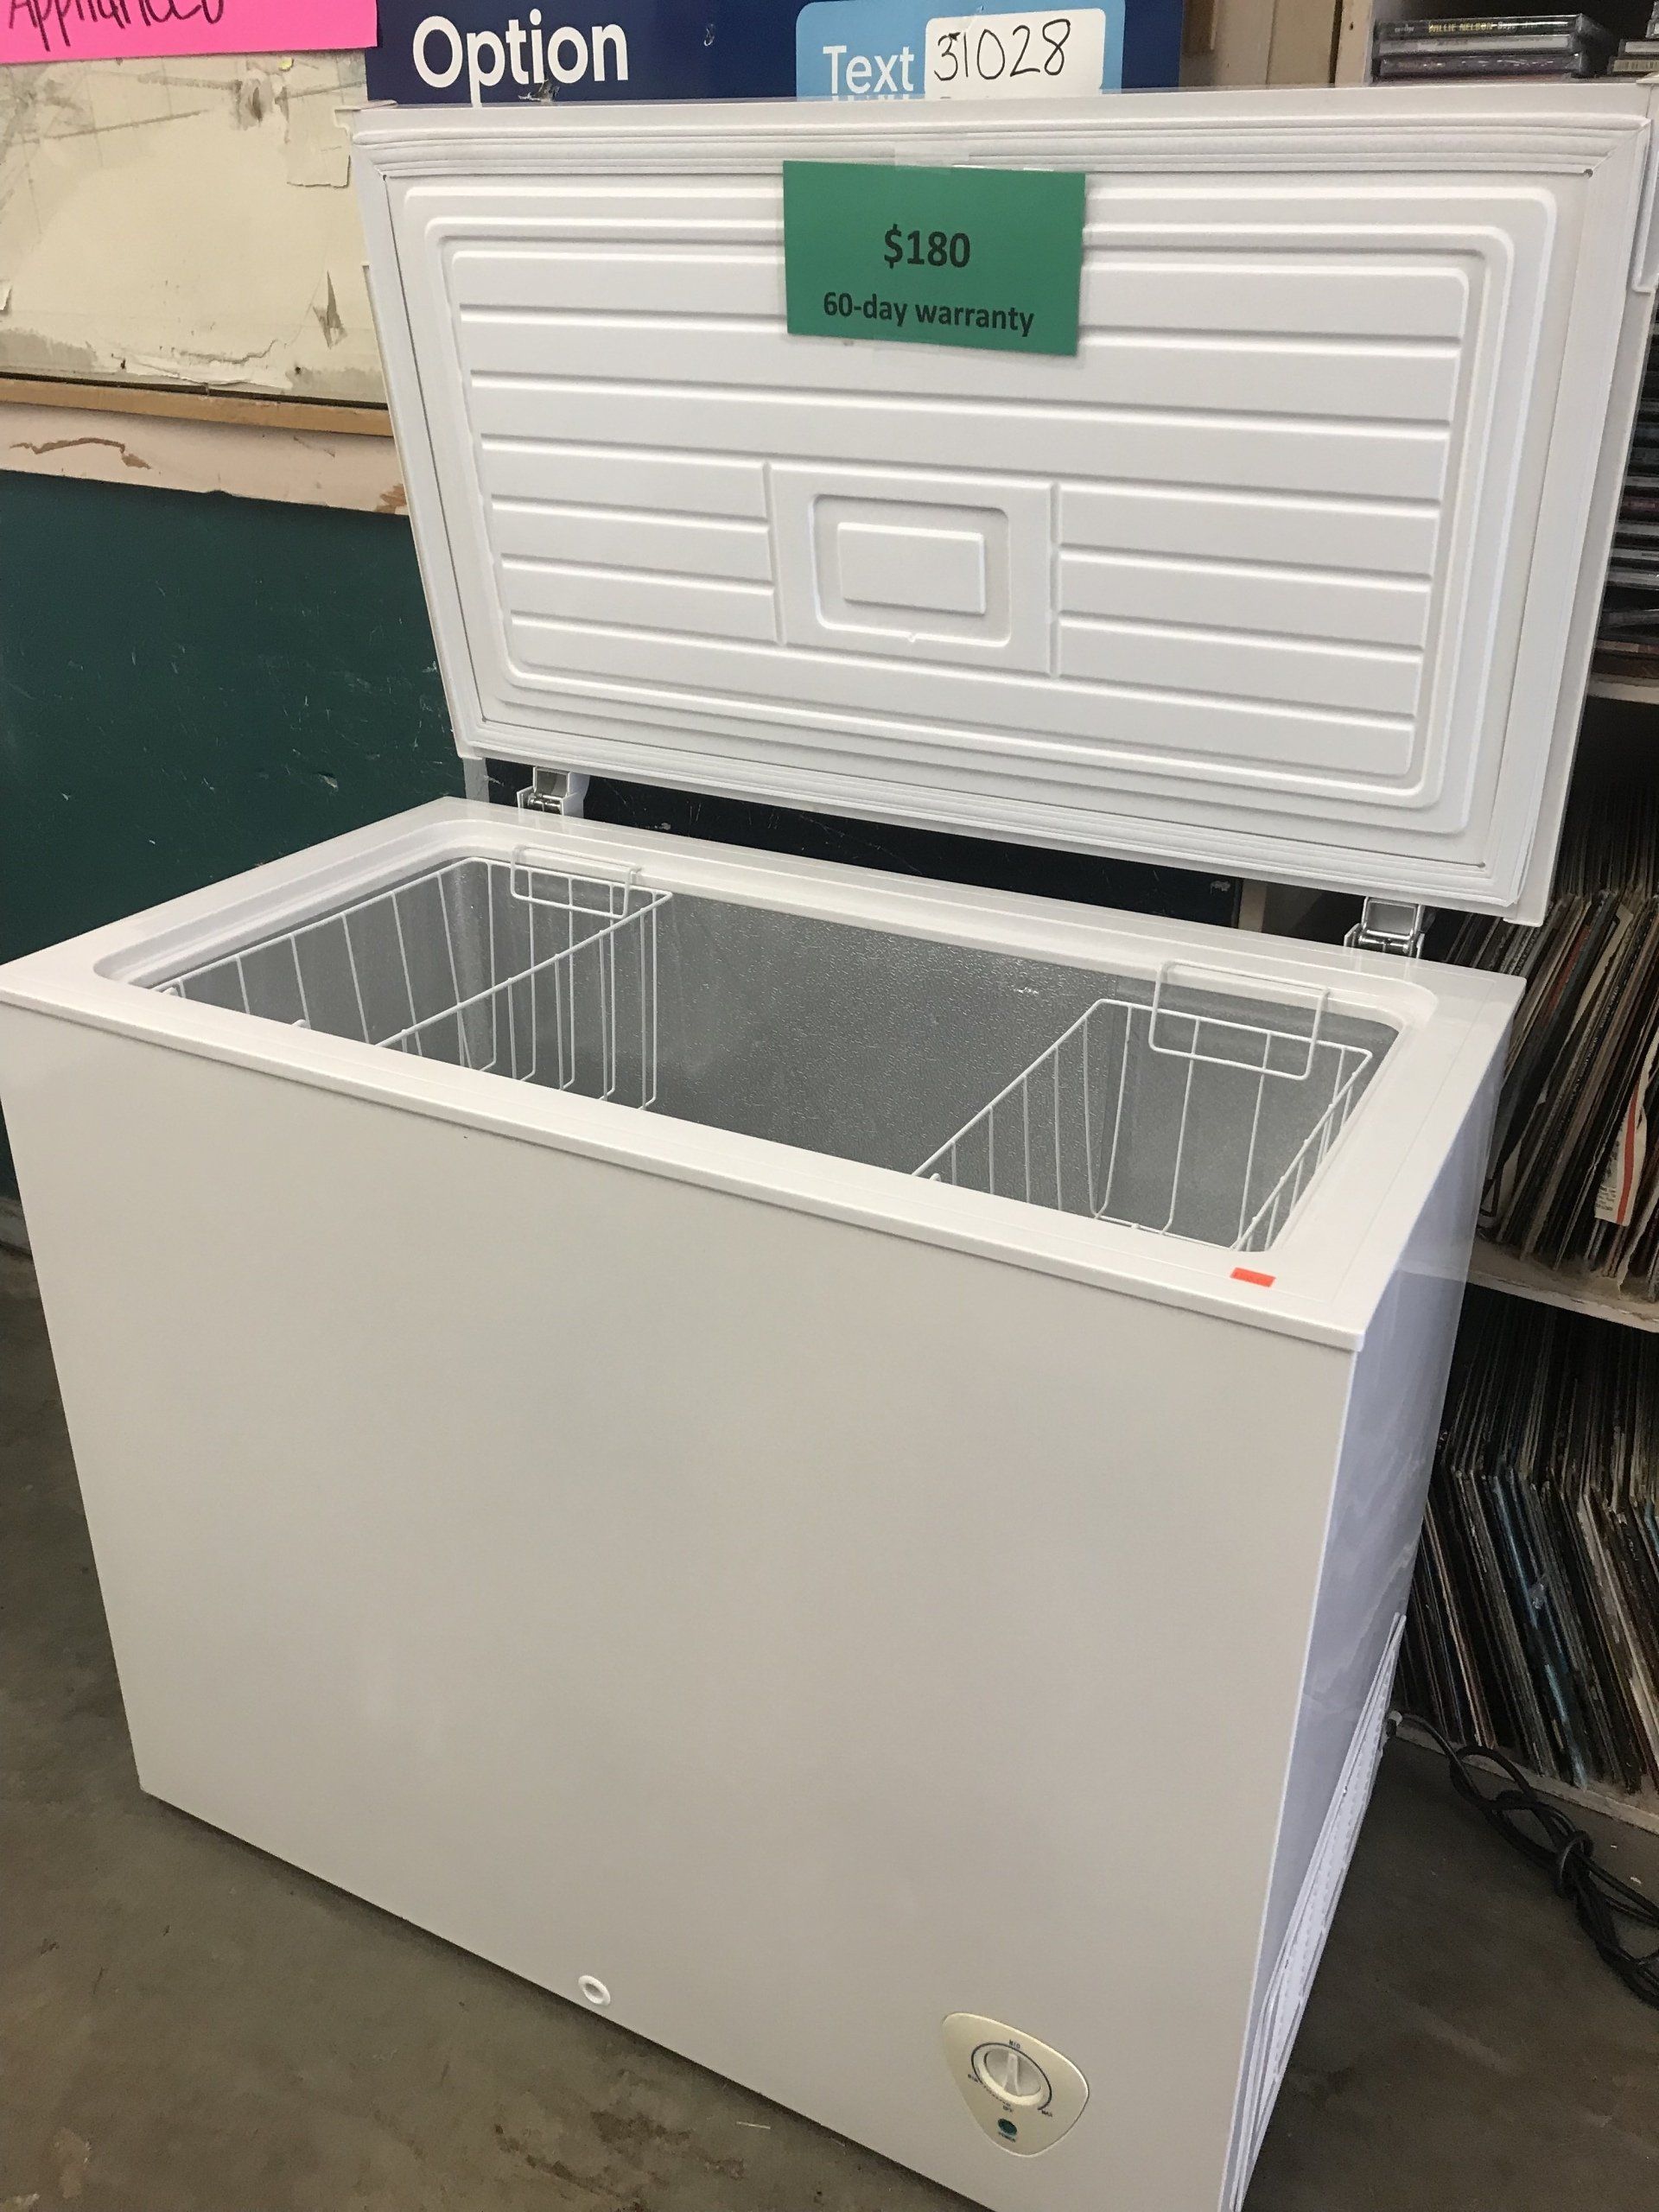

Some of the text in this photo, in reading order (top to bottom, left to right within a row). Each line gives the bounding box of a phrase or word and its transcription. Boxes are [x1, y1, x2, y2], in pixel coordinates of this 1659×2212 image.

[413, 9, 629, 107] Option
[823, 18, 1071, 94] Text 31028
[884, 224, 970, 269] $180
[823, 292, 1034, 337] 60-day warranty
